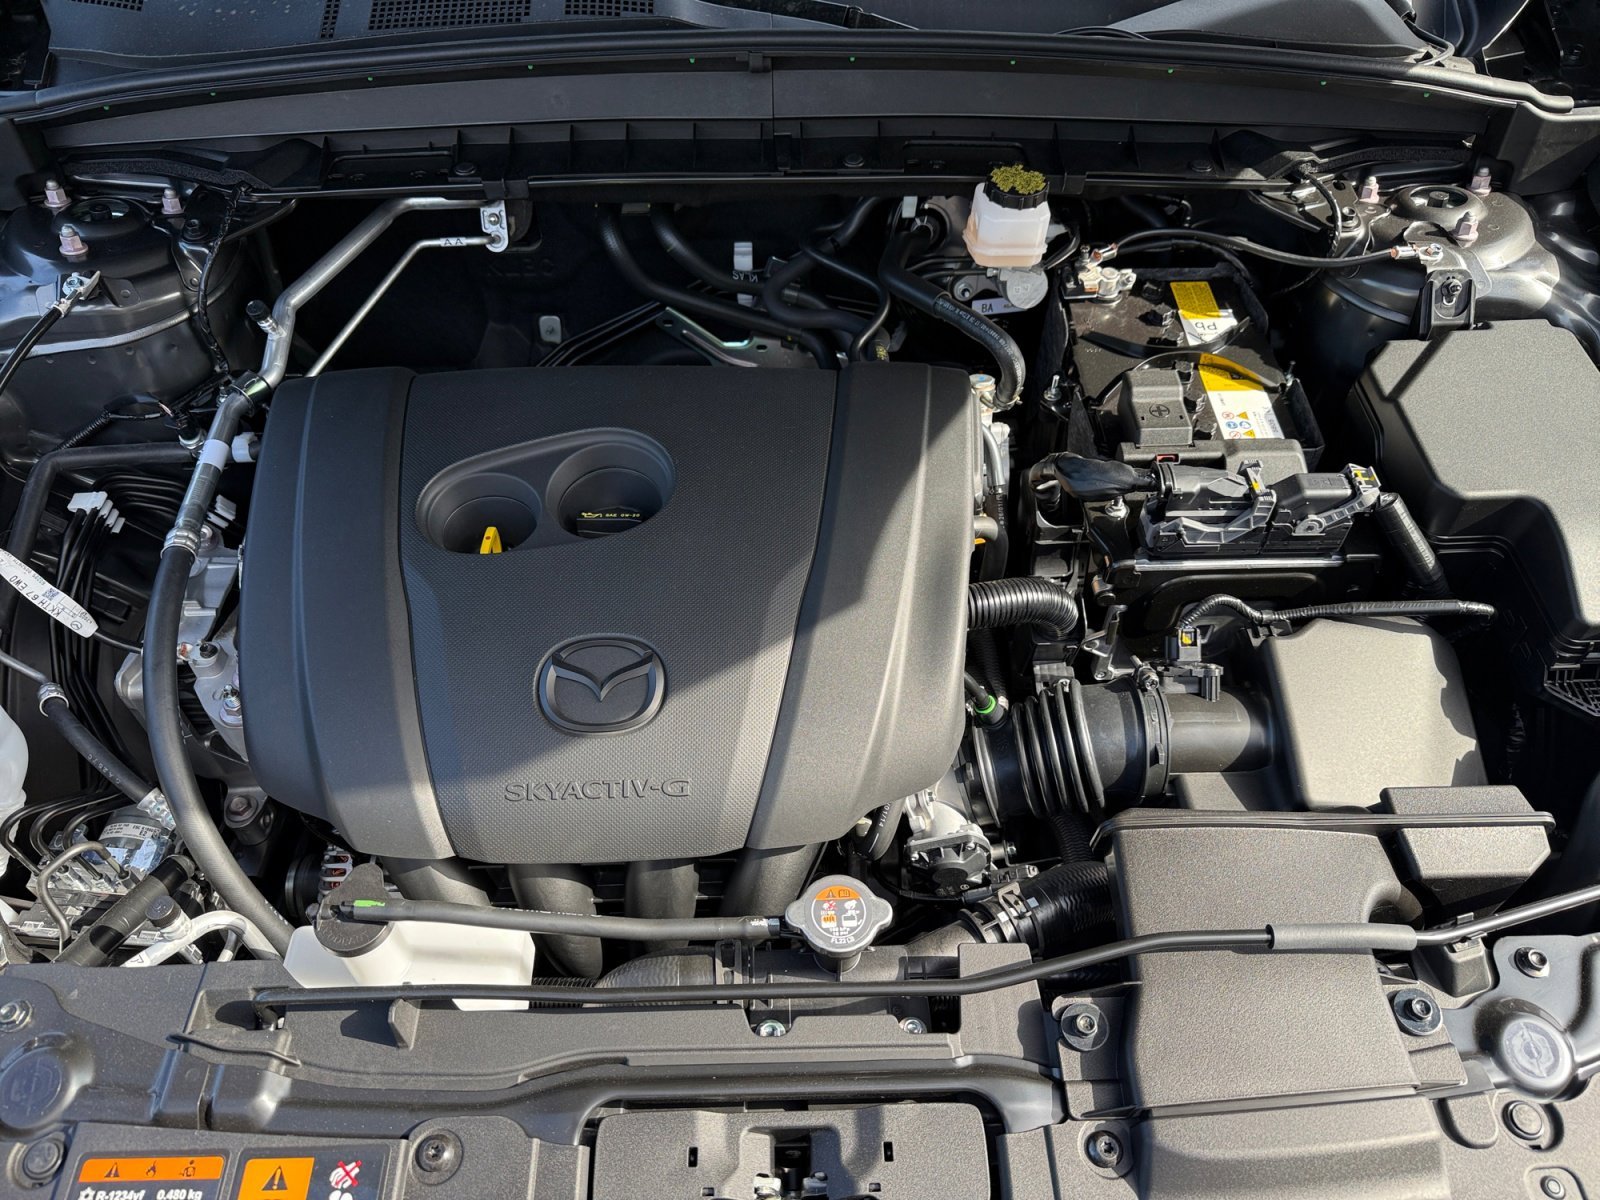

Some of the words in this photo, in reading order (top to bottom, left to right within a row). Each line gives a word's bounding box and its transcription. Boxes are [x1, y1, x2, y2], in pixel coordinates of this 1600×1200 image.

[732, 270, 758, 283] KLAS
[981, 303, 994, 313] BA
[1194, 321, 1218, 331] Pb
[25, 590, 40, 601] 67
[37, 599, 62, 618] KKTH
[504, 777, 692, 801] SKYACTIV-G
[95, 1190, 146, 1200] R-1234yf
[156, 1189, 187, 1200] 0.480
[188, 1188, 203, 1200] kg
